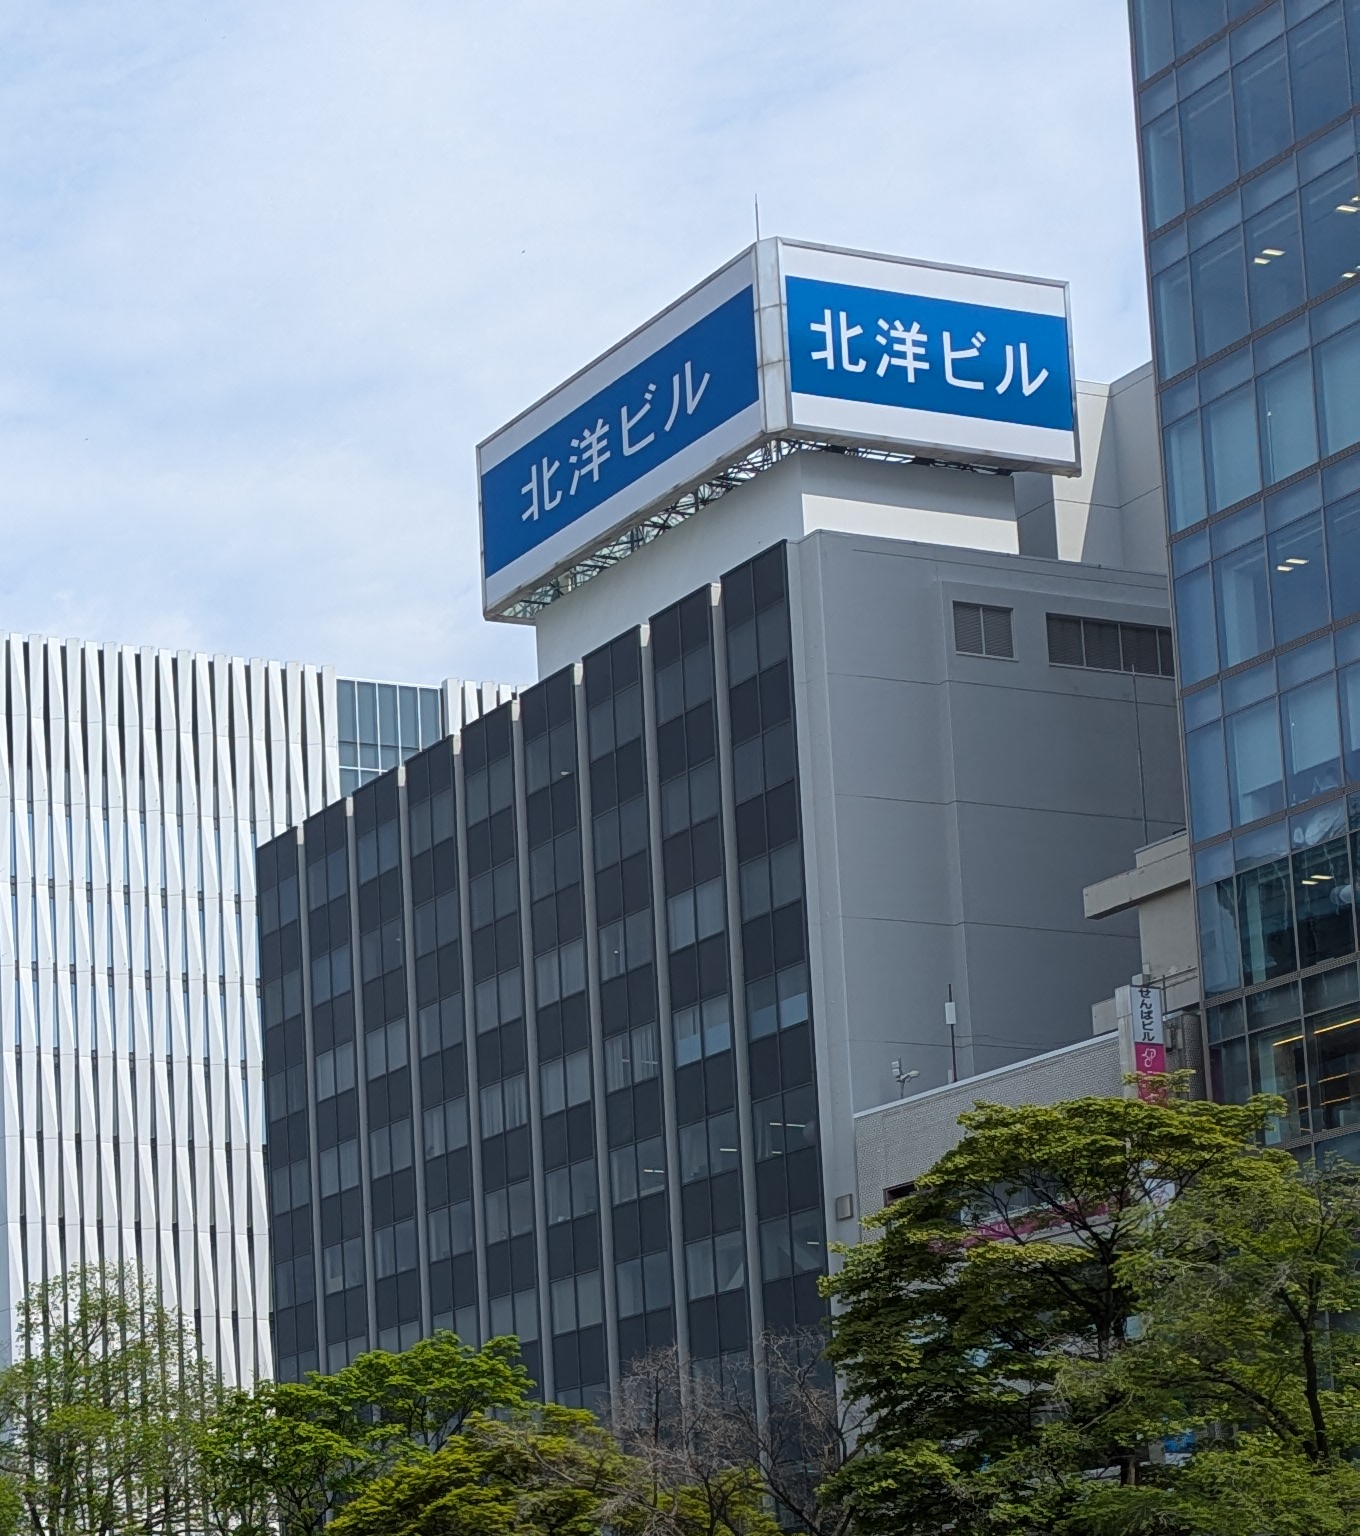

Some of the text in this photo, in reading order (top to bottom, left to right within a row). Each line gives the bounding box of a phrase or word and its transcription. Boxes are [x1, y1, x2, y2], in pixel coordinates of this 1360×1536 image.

[809, 308, 1049, 398] 北洋ビル
[520, 360, 711, 522] 北洋ビル
